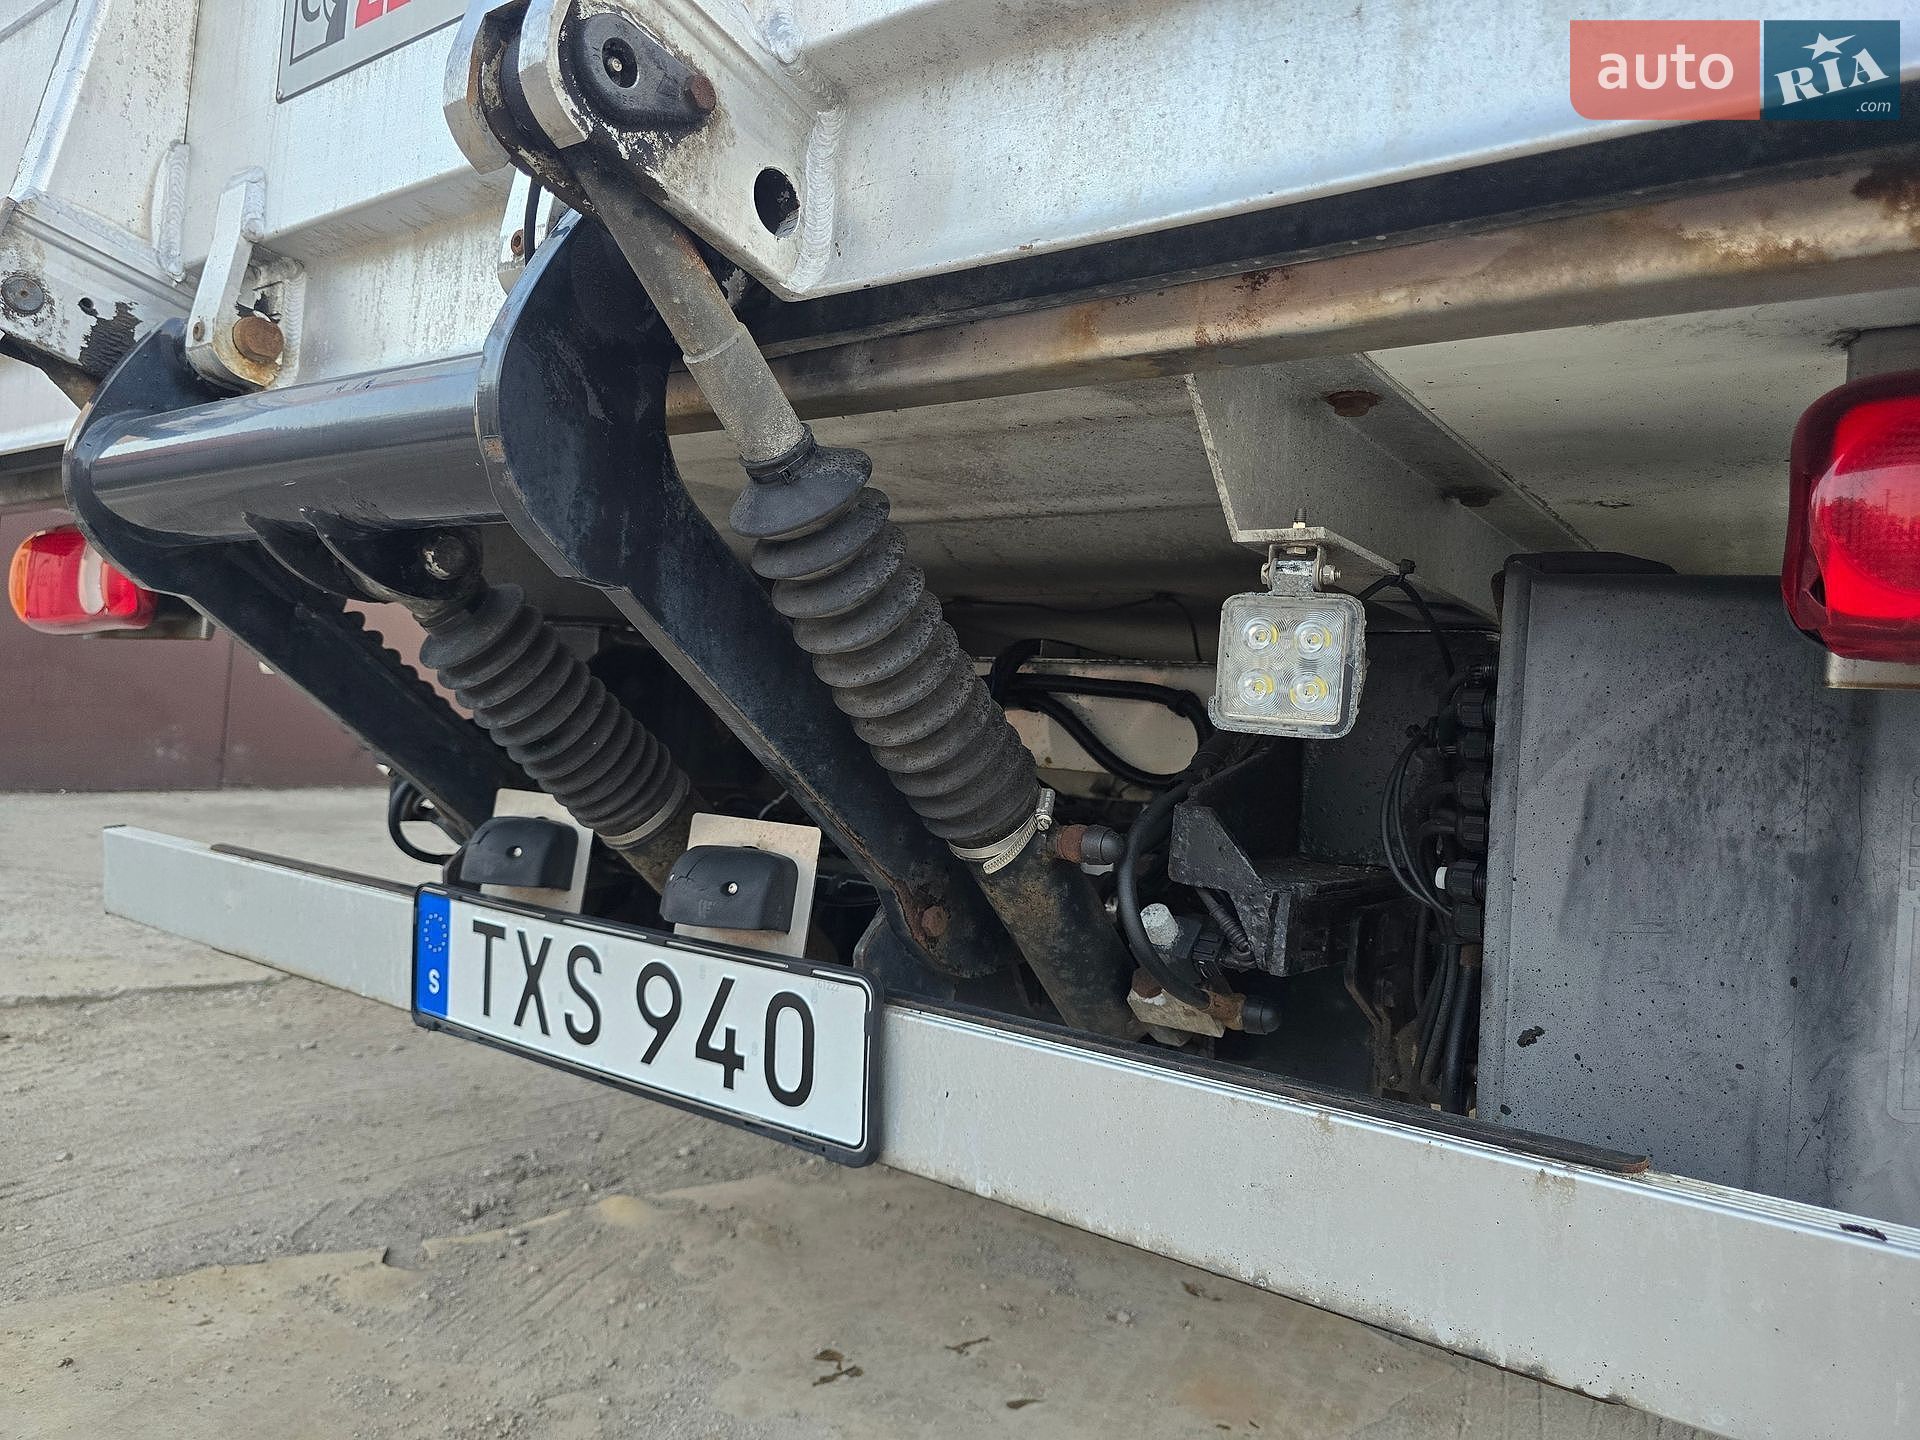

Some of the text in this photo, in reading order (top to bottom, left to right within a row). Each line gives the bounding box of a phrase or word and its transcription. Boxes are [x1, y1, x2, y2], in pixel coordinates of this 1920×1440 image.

[428, 968, 440, 994] S
[472, 920, 815, 1108] TXS 940
